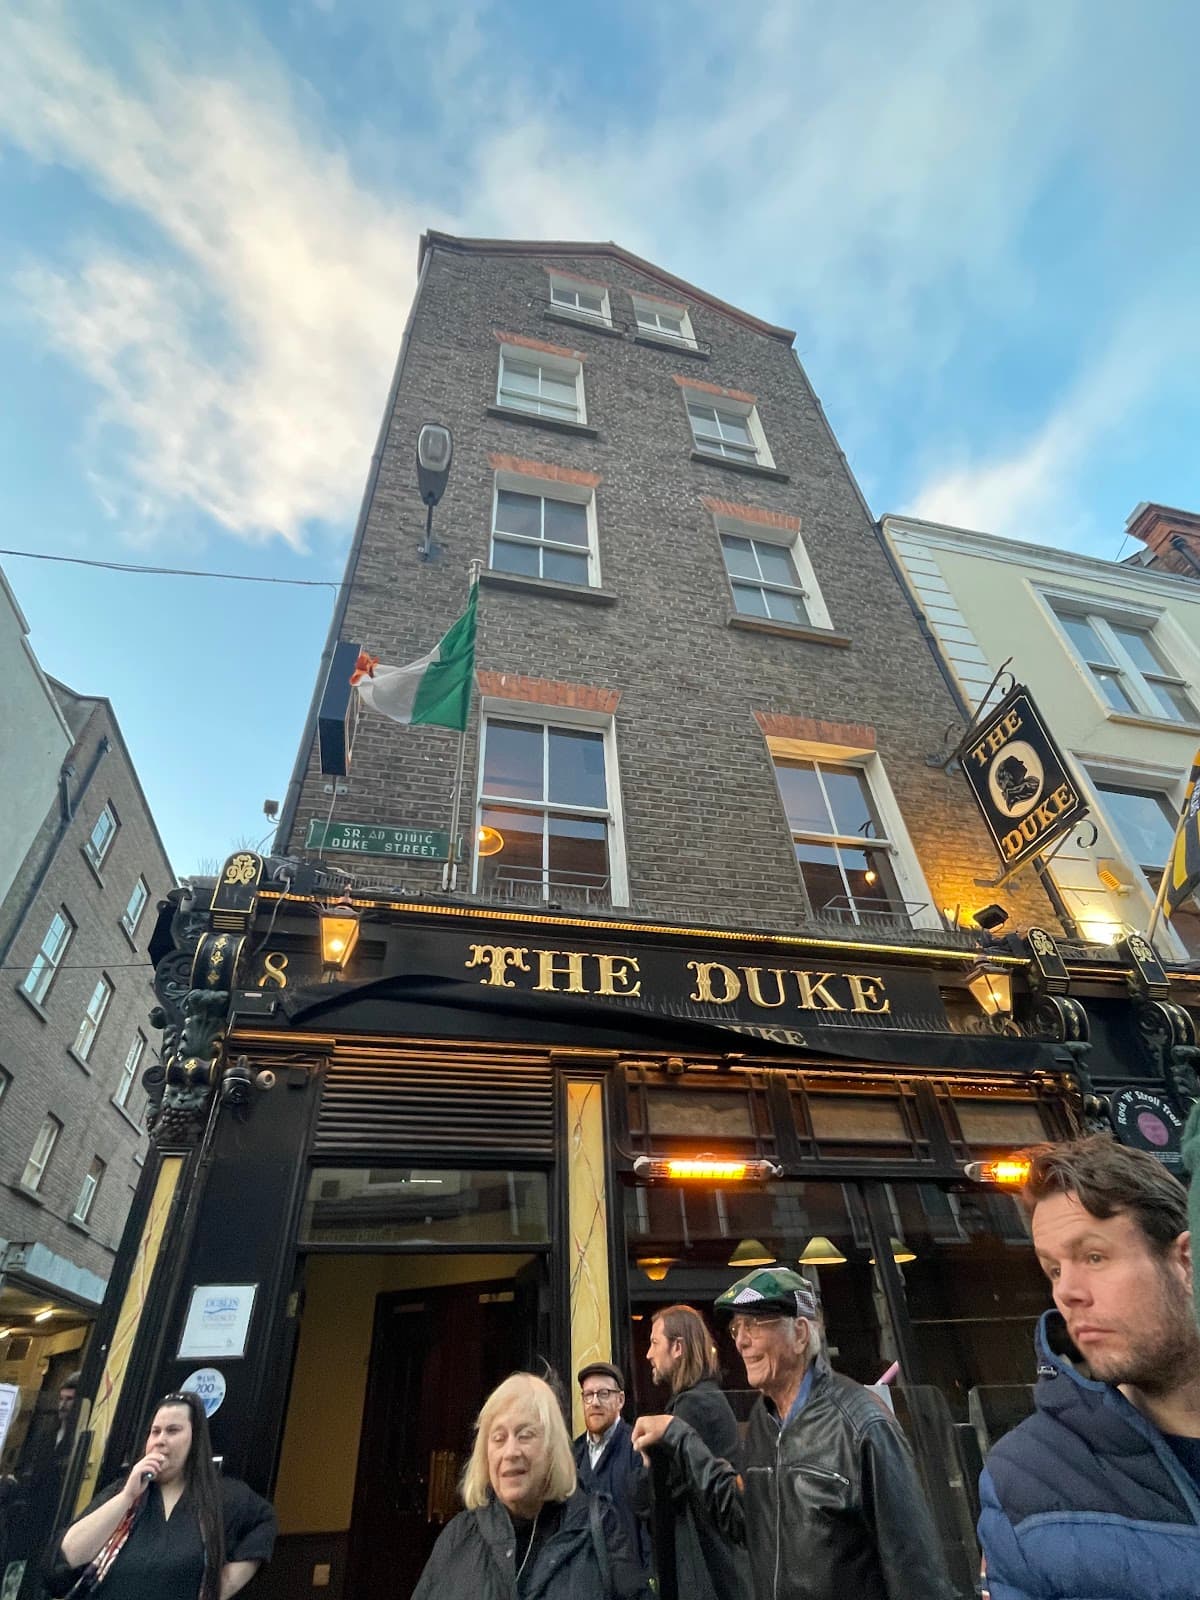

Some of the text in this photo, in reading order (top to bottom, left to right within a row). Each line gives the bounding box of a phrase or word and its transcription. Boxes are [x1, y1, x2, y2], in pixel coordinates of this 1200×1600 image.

[971, 708, 1024, 767] THE
[332, 838, 369, 850] DUKE
[1001, 783, 1075, 858] DUKE
[258, 952, 288, 989] 8
[464, 944, 891, 1015] THE DUKE
[1117, 1101, 1128, 1125] Rock
[1134, 1090, 1161, 1107] Stroll
[1162, 1103, 1182, 1127] Trail
